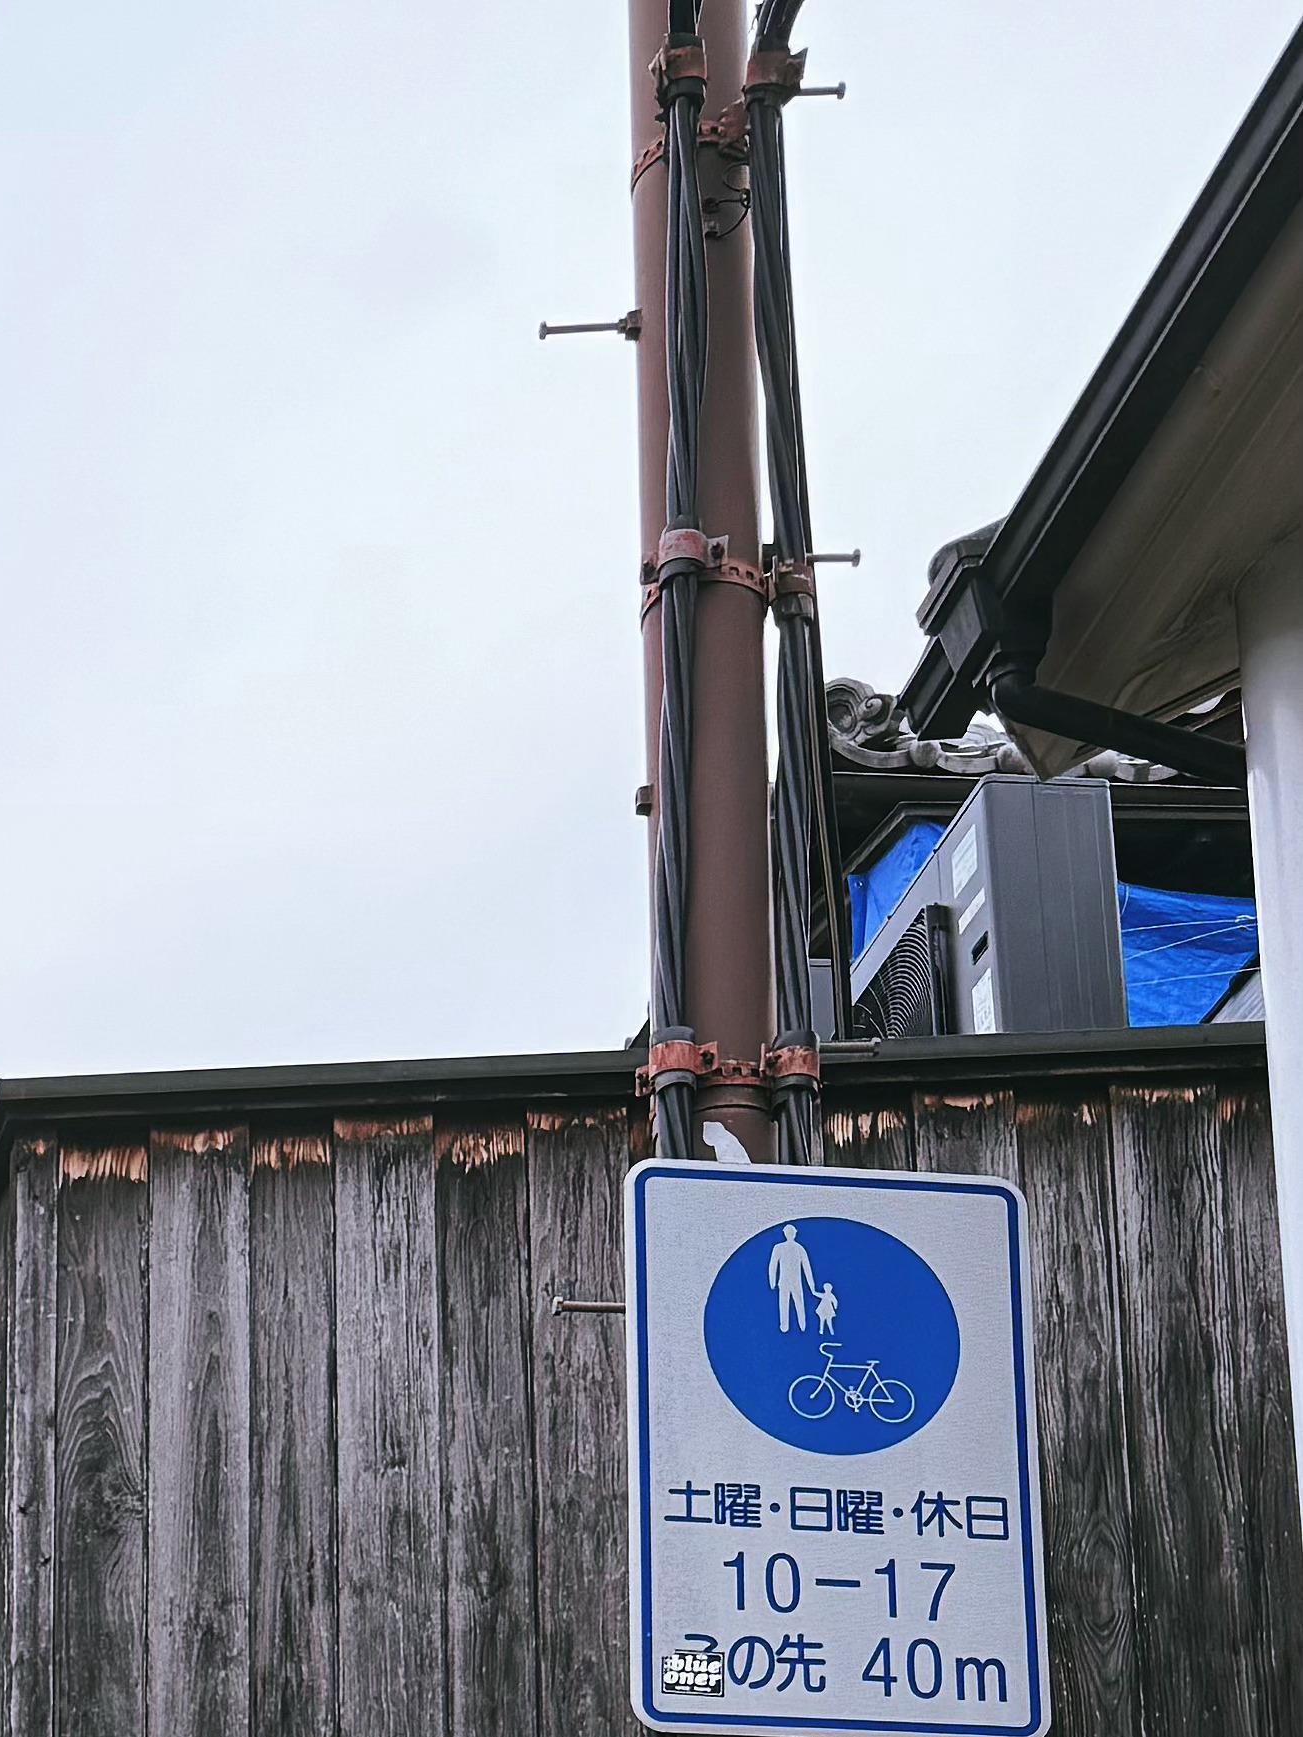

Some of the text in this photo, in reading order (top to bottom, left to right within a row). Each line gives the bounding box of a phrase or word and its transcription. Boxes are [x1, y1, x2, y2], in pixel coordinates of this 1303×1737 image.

[663, 1480, 1010, 1541] 土曜・日曜・休日
